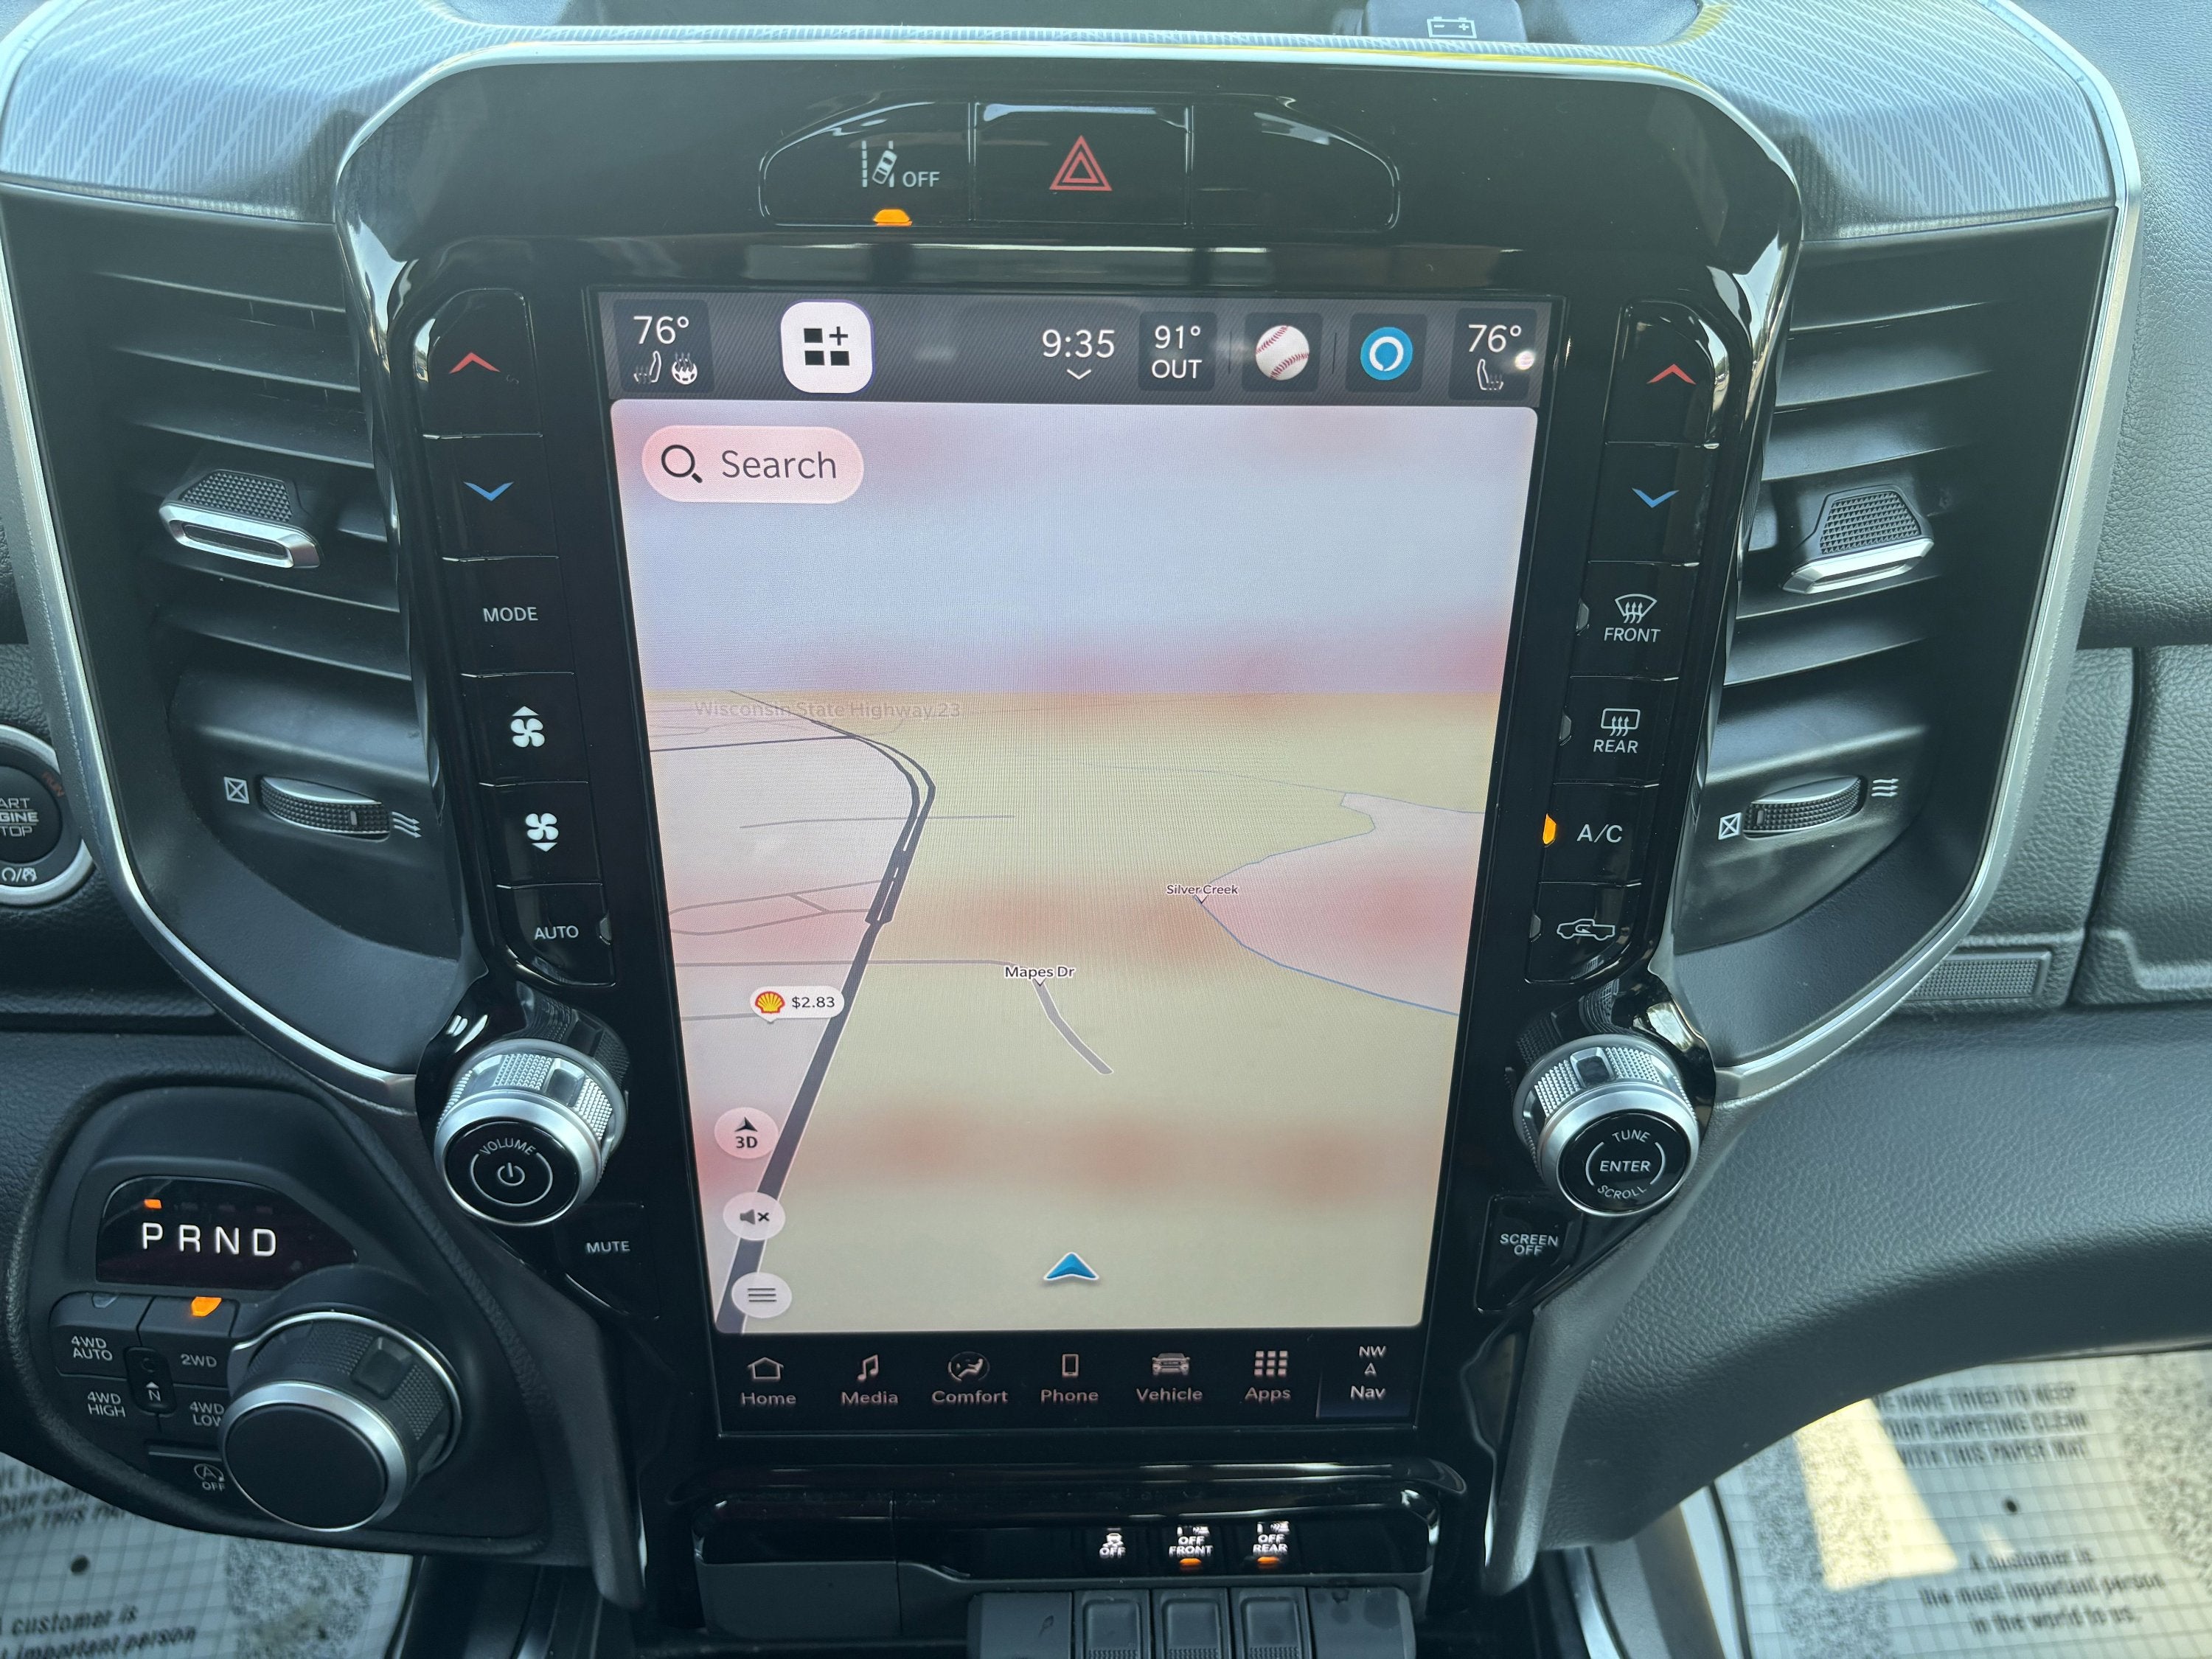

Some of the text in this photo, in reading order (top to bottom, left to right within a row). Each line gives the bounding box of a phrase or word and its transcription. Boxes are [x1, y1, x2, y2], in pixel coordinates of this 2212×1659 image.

[903, 171, 940, 188] OFF
[633, 315, 690, 345] 76°
[1154, 324, 1201, 349] 91°
[1041, 329, 1116, 358] 9:35
[1468, 324, 1522, 353] 76°
[1151, 359, 1203, 380] OUT
[720, 449, 838, 479] Search
[483, 607, 539, 622] MODE
[1604, 627, 1661, 643] FRONT
[695, 701, 961, 722] Wisconsin State Highway 23
[1593, 740, 1638, 754] REAR
[1576, 824, 1623, 844] A/C
[1166, 885, 1239, 895] Silver Creek
[535, 925, 580, 940] AUTO
[1004, 967, 1075, 981] Mapes Dr
[792, 995, 835, 1009] $2.83
[736, 1135, 759, 1149] 3D
[1612, 1129, 1651, 1143] TUNE
[479, 1137, 537, 1156] VOLUME
[1599, 1160, 1651, 1172] ENTER
[1597, 1184, 1647, 1200] SCROLL
[142, 1222, 277, 1256] P R N D
[1500, 1234, 1559, 1246] SCREEN
[585, 1240, 631, 1253] MUTE
[1514, 1245, 1544, 1256] OFF
[72, 1335, 107, 1349] 4WD
[73, 1348, 113, 1362] AUTO
[1359, 1346, 1387, 1357] NW
[180, 1354, 218, 1368] 2WD
[87, 1391, 122, 1405] 4WD
[148, 1390, 161, 1402] N
[740, 1391, 797, 1405] Home
[841, 1391, 899, 1405] Media
[931, 1390, 1009, 1405] Comfort
[1040, 1389, 1099, 1403] Phone
[1135, 1387, 1203, 1402] Vehicle
[1245, 1387, 1292, 1403] Apps
[1350, 1385, 1387, 1399] Nav
[88, 1404, 126, 1418] HIGH
[189, 1401, 225, 1416] 4WD
[202, 1481, 226, 1492] OFF
[1178, 1536, 1206, 1546] OFF
[1258, 1534, 1284, 1544] OFF
[1099, 1547, 1126, 1559] OFF
[1169, 1545, 1214, 1557] FRONT
[1253, 1543, 1288, 1554] REAR
